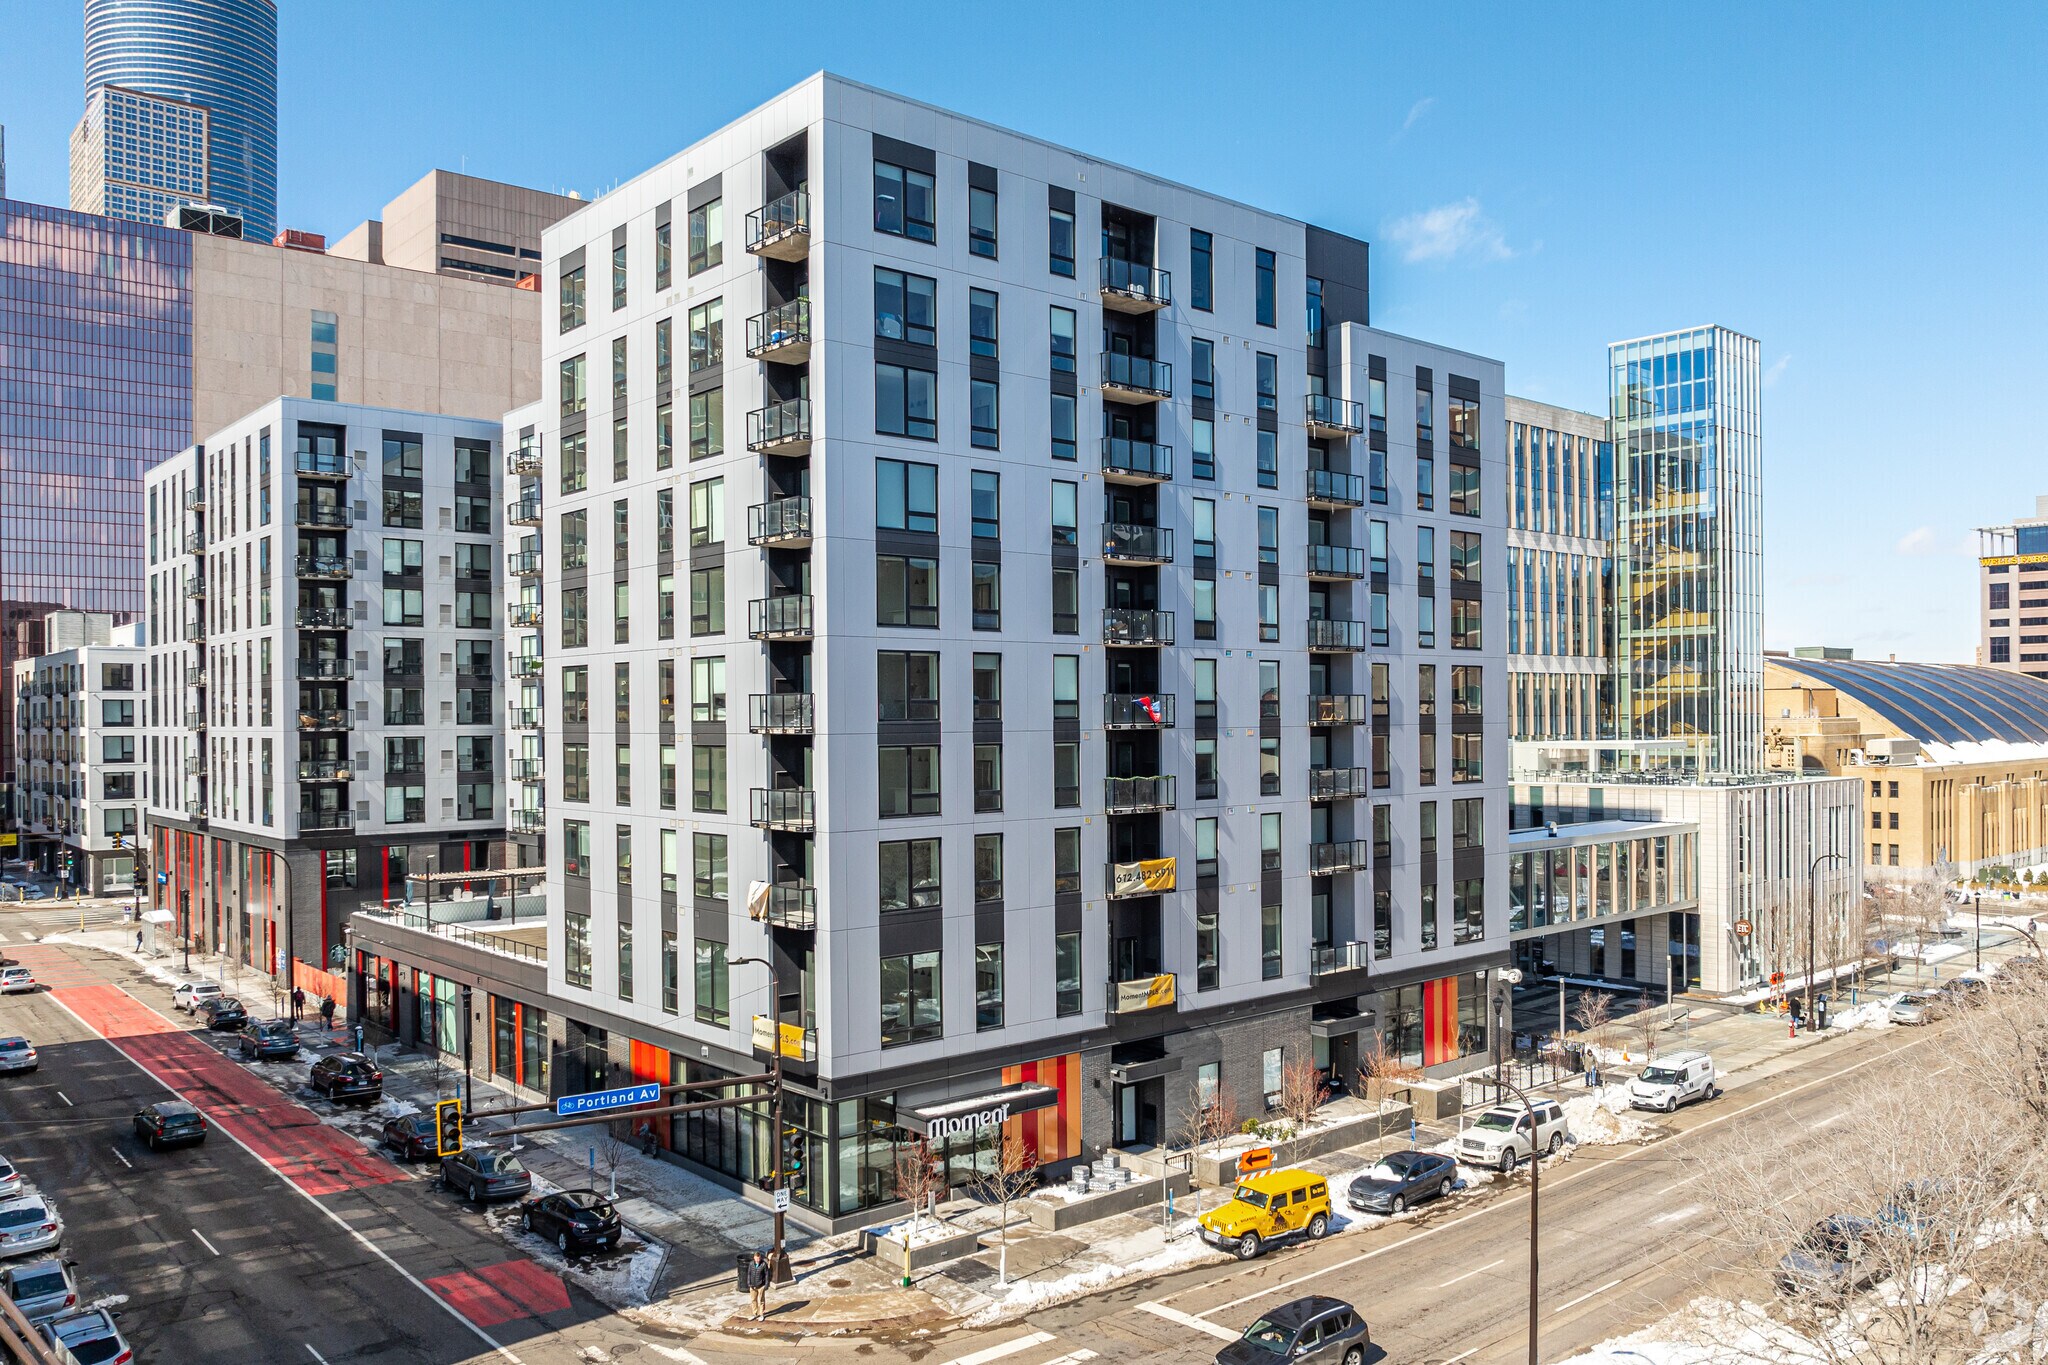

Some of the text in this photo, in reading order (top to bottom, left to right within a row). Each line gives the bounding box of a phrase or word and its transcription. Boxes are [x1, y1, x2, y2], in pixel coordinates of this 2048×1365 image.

[1980, 556, 2018, 566] WELLS
[577, 1089, 657, 1109] Portland Av
[776, 1190, 787, 1198] ONE
